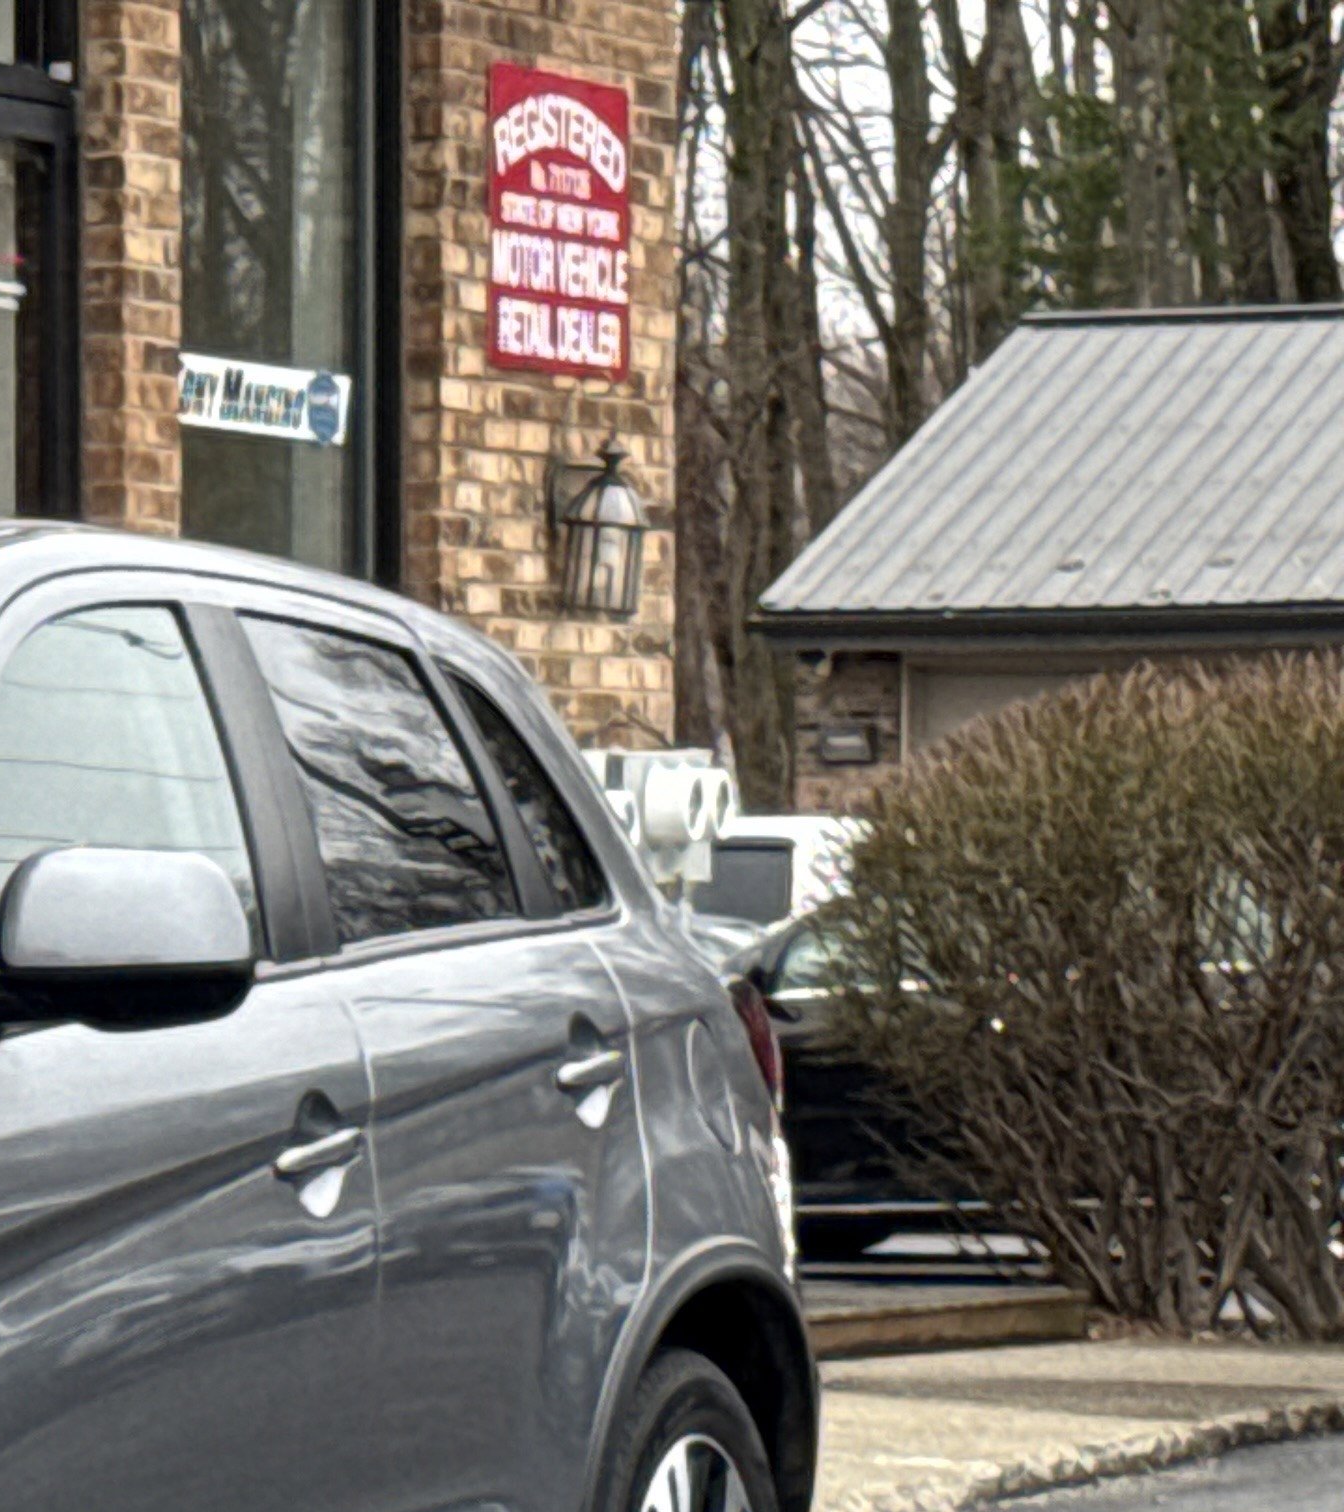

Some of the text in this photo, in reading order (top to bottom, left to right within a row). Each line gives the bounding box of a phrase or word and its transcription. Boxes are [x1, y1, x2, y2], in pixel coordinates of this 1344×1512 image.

[493, 94, 626, 192] REGISTERED
[492, 230, 629, 304] MOTOR VEHICLE
[498, 296, 621, 368] RETAIL DEALER
[177, 368, 220, 418] ONY
